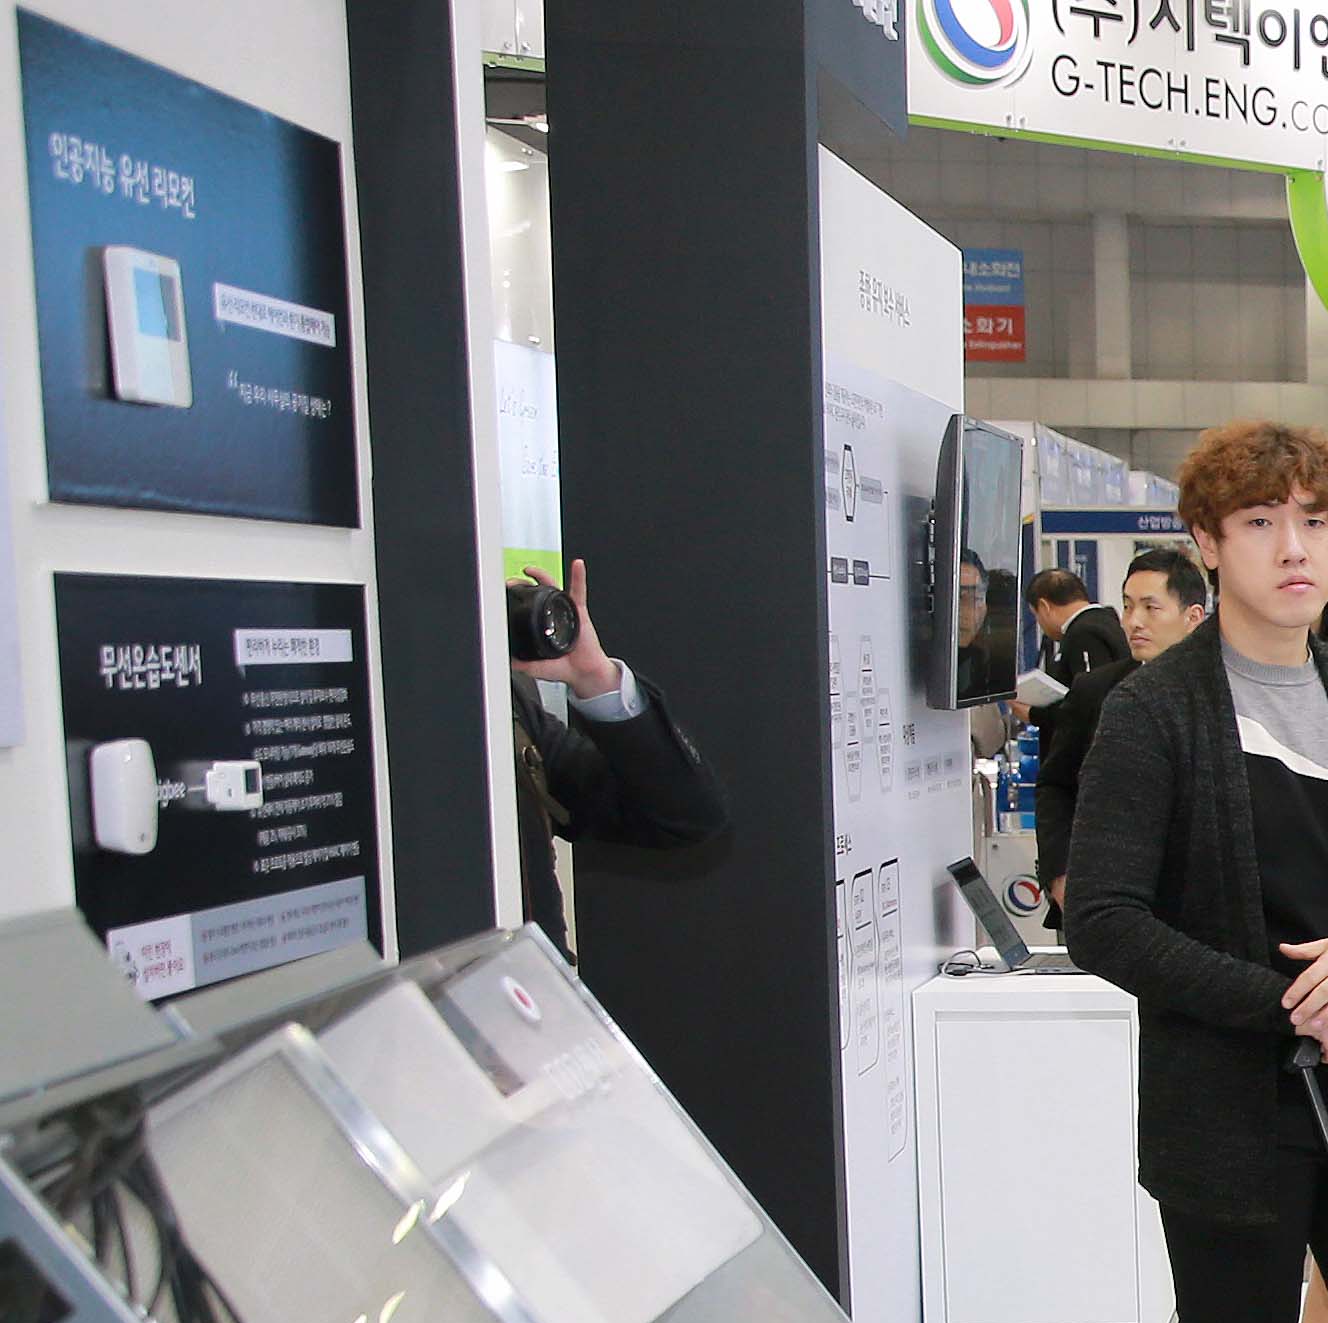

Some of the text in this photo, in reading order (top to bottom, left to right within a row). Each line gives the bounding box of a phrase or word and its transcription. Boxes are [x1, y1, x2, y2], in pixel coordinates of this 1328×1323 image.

[49, 132, 196, 218] 인공지능 유선 리모컨
[99, 642, 204, 690] 무선온습도센서
